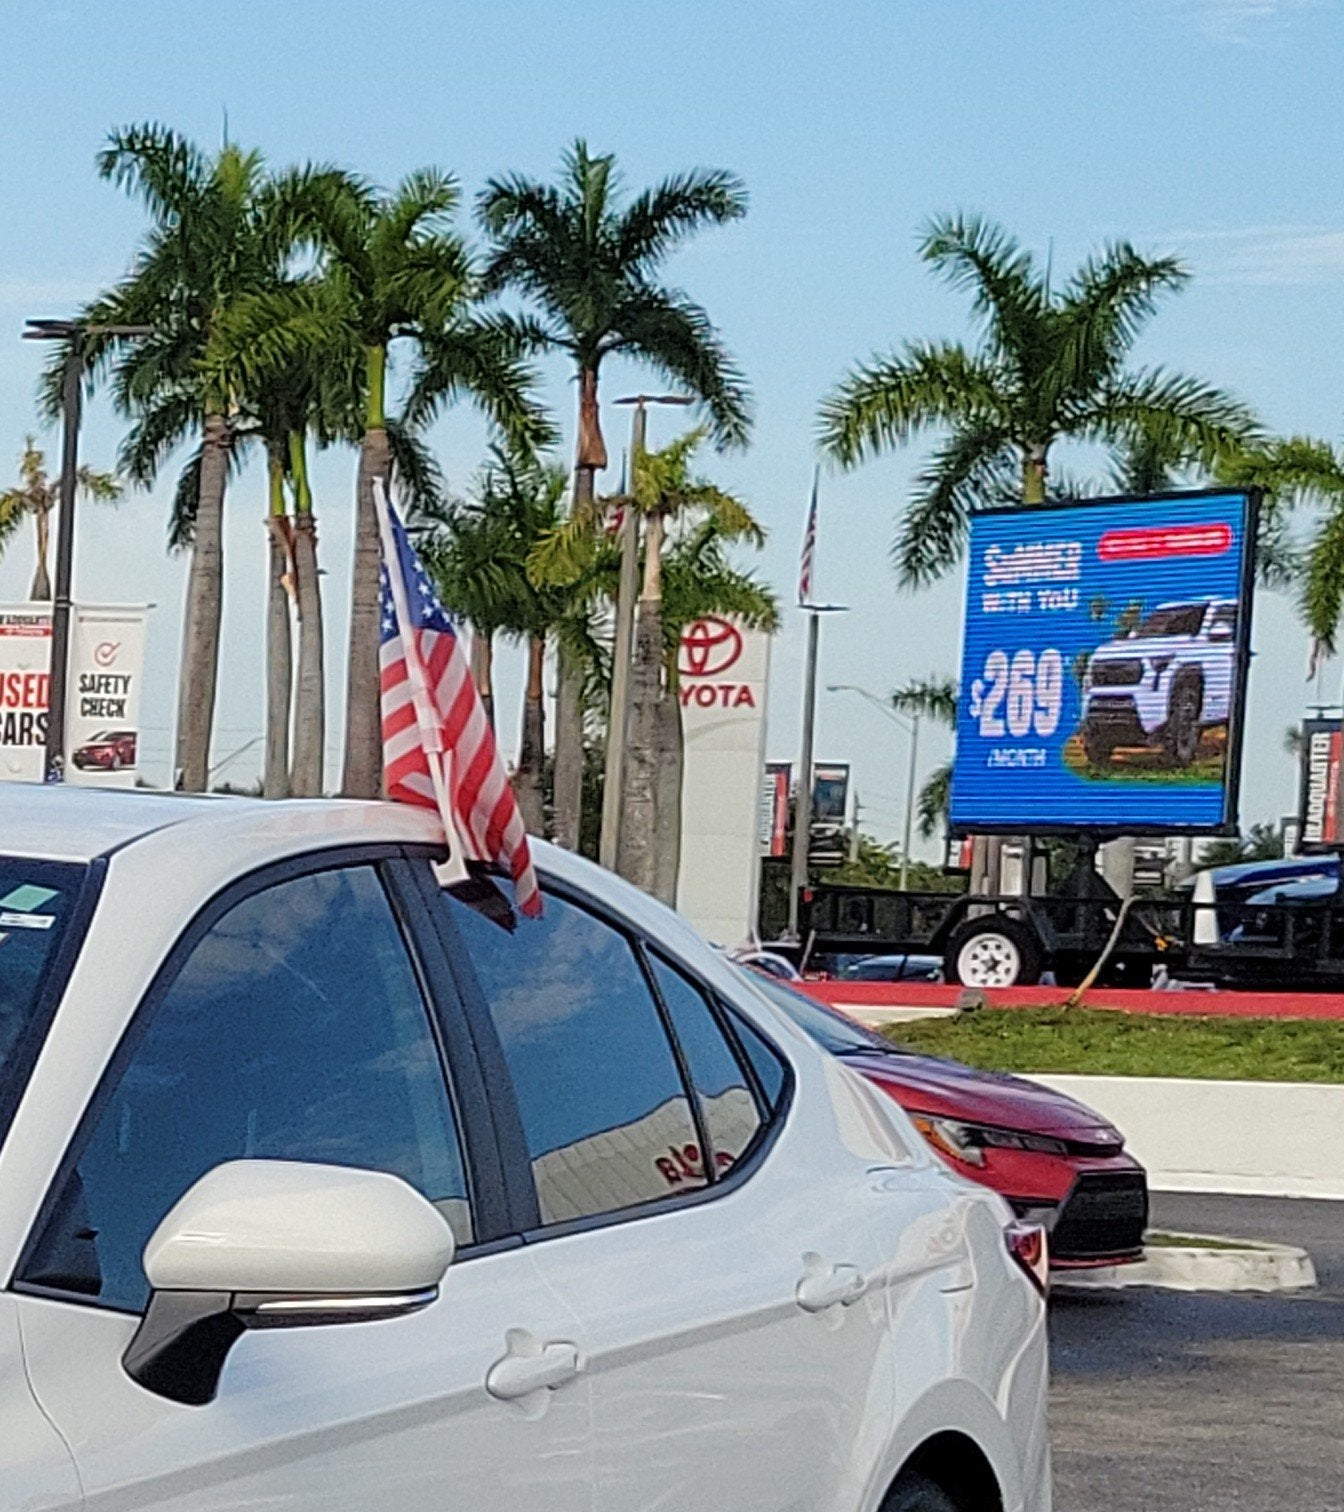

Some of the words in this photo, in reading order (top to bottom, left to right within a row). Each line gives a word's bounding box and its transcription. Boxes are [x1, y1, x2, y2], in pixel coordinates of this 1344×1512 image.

[79, 673, 131, 694] SAFETY
[970, 649, 1062, 737] $269
[679, 684, 756, 708] YOTA
[80, 697, 126, 718] CHECK
